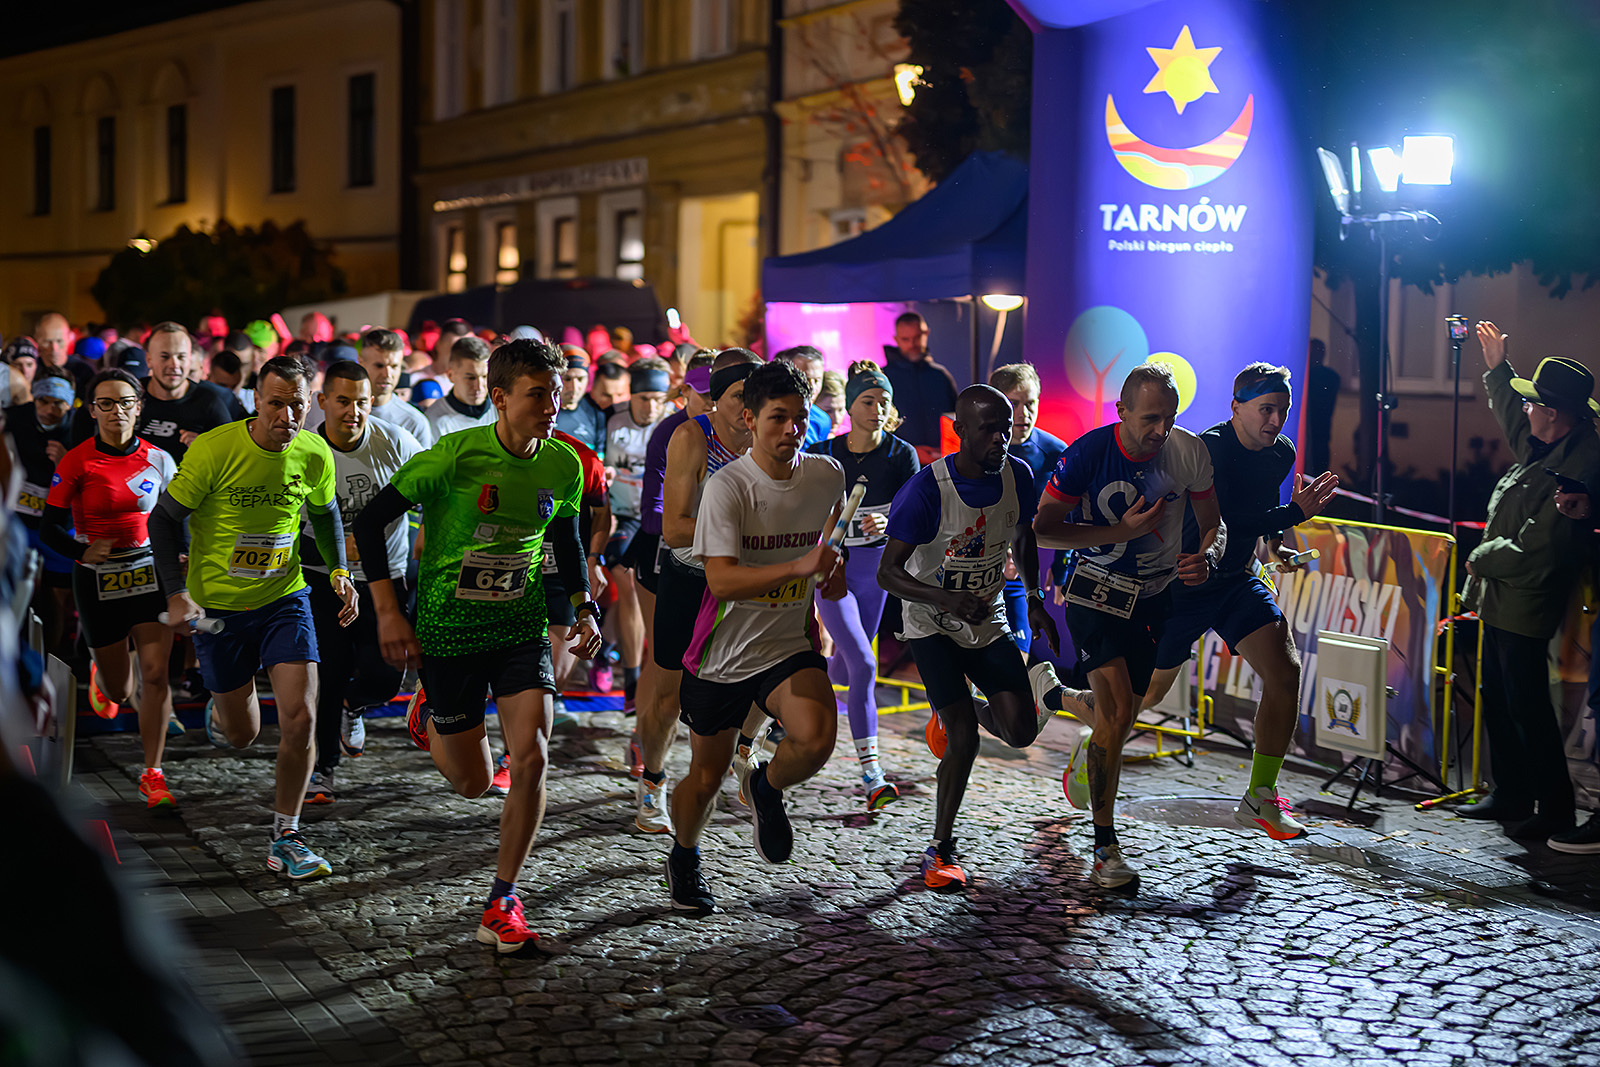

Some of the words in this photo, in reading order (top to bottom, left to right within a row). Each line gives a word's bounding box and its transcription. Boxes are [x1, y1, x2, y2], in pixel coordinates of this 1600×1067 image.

[1099, 196, 1248, 232] TARNÓW
[1108, 239, 1145, 251] Polski
[1147, 240, 1192, 254] biegun
[234, 550, 283, 567] 702/1
[102, 567, 148, 591] 205
[475, 569, 514, 591] 64
[950, 567, 996, 590] 150
[759, 583, 798, 599] 8/1
[1091, 584, 1110, 603] 5
[1274, 568, 1402, 650] NOWSKI
